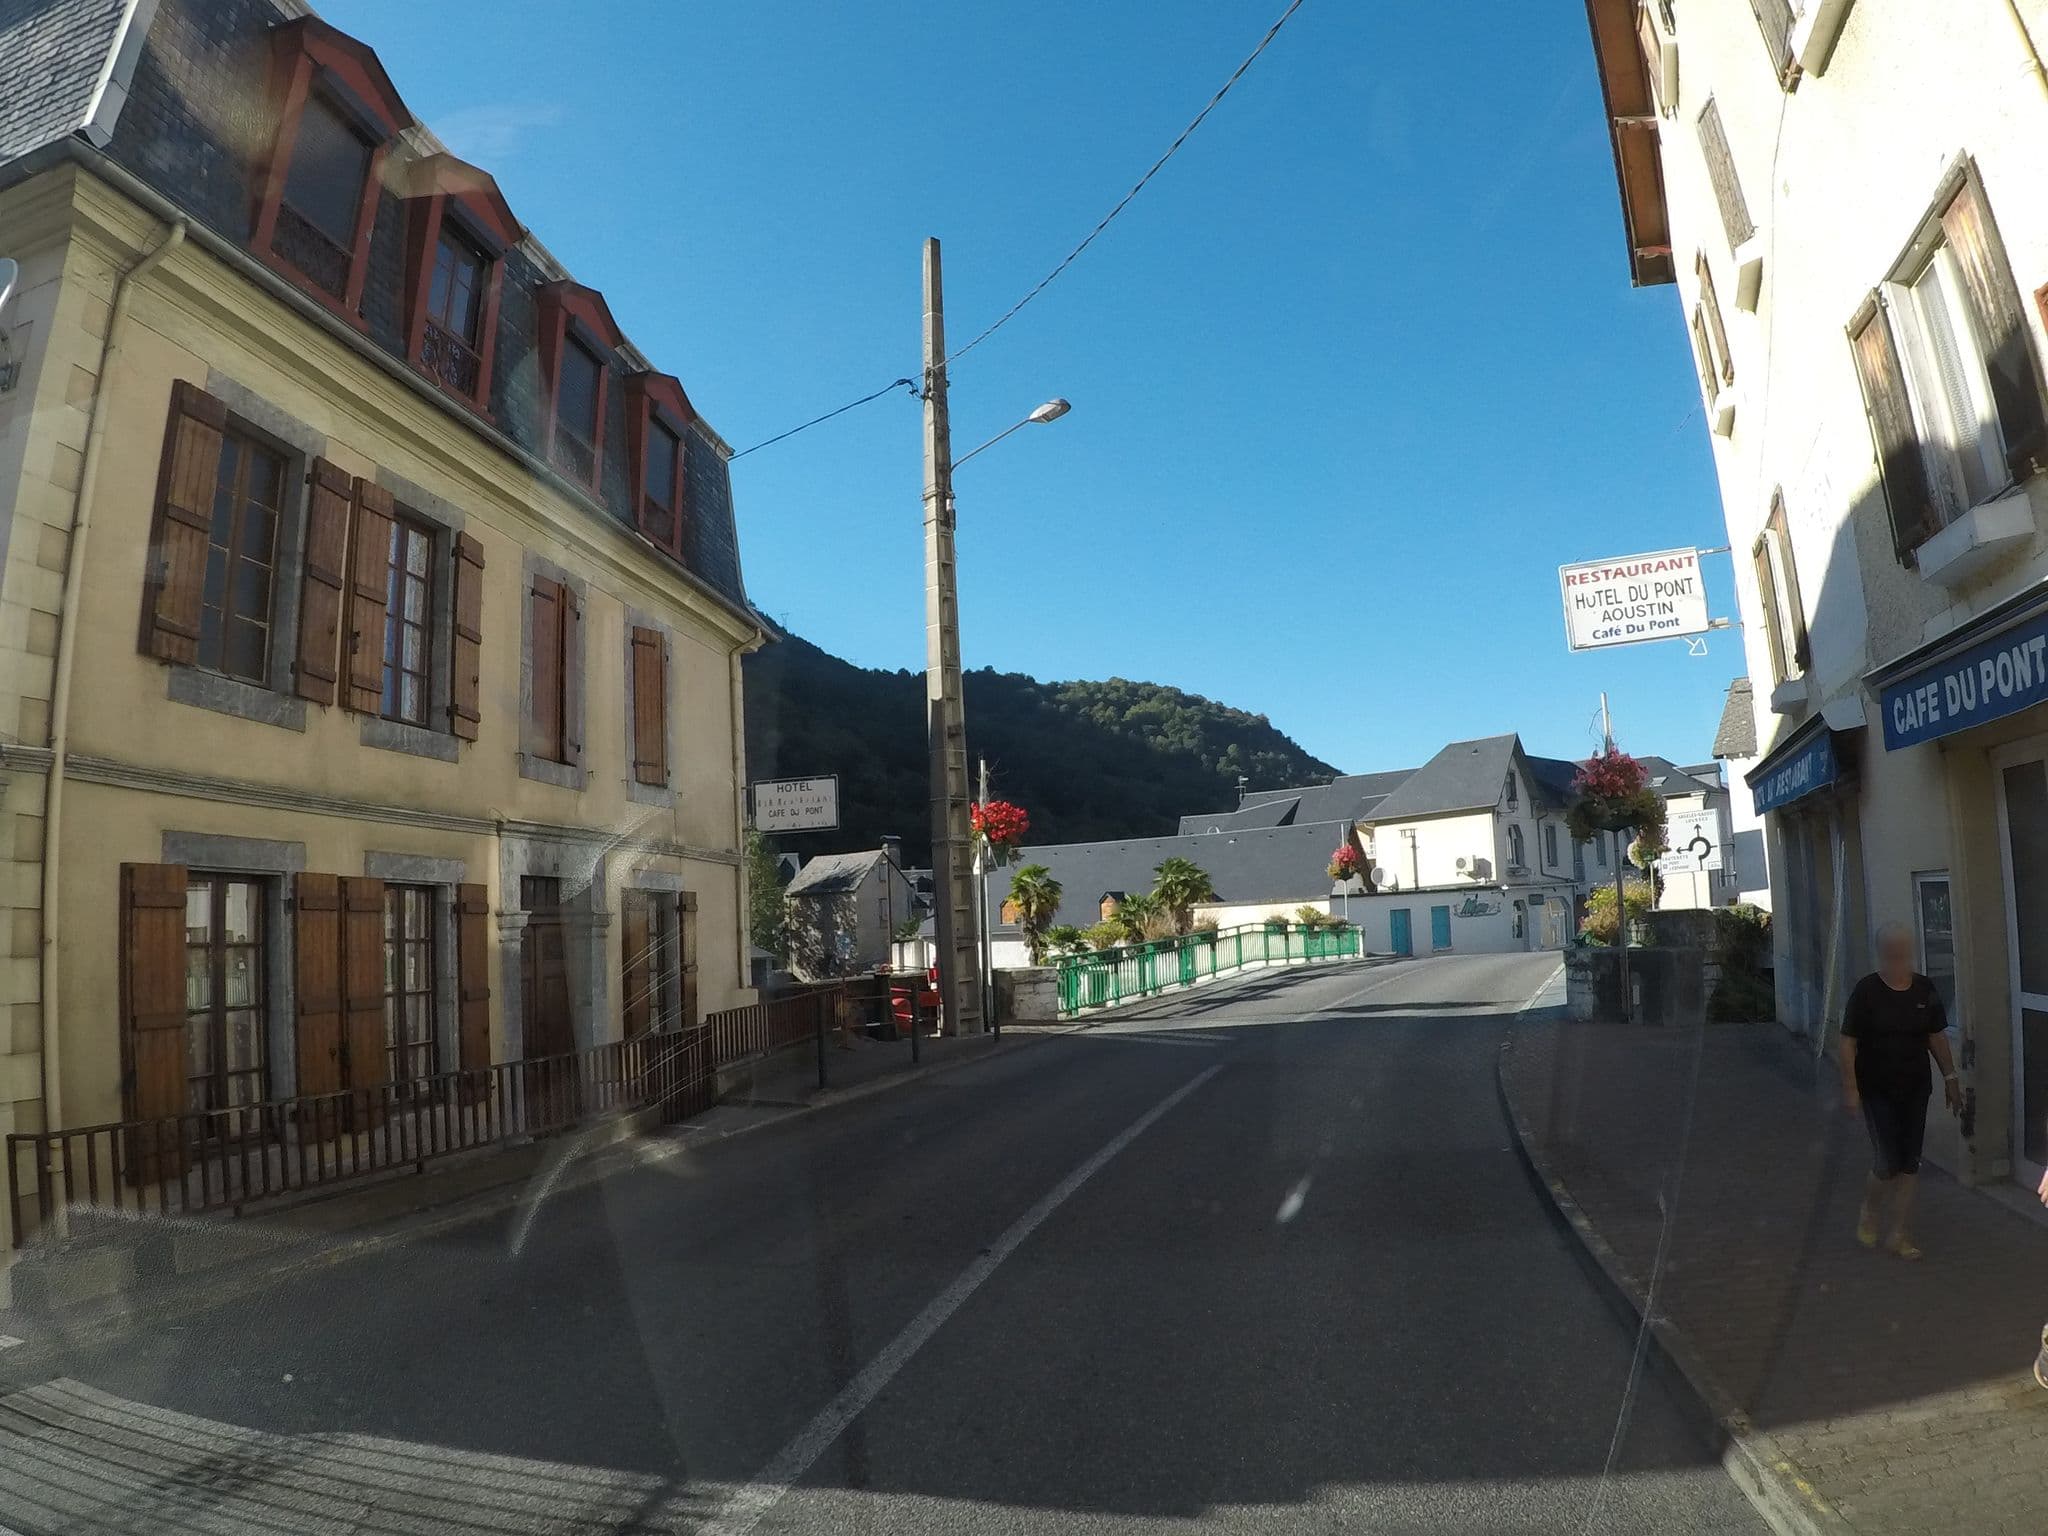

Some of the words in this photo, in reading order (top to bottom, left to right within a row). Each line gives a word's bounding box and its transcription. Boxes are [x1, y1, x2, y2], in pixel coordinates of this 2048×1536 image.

[1565, 555, 1695, 586] RESTAURANT
[1628, 584, 1649, 602] DU
[1654, 577, 1693, 598] PONT
[1602, 601, 1674, 623] AOUSTIN
[1592, 624, 1621, 640] Café
[1626, 623, 1645, 635] Du
[1650, 617, 1680, 631] Pont
[1893, 681, 1940, 734] CAFE
[1944, 666, 1976, 717] DU
[1979, 634, 2046, 704] PONT
[777, 782, 812, 793] HOTEL
[805, 806, 823, 815] PONT
